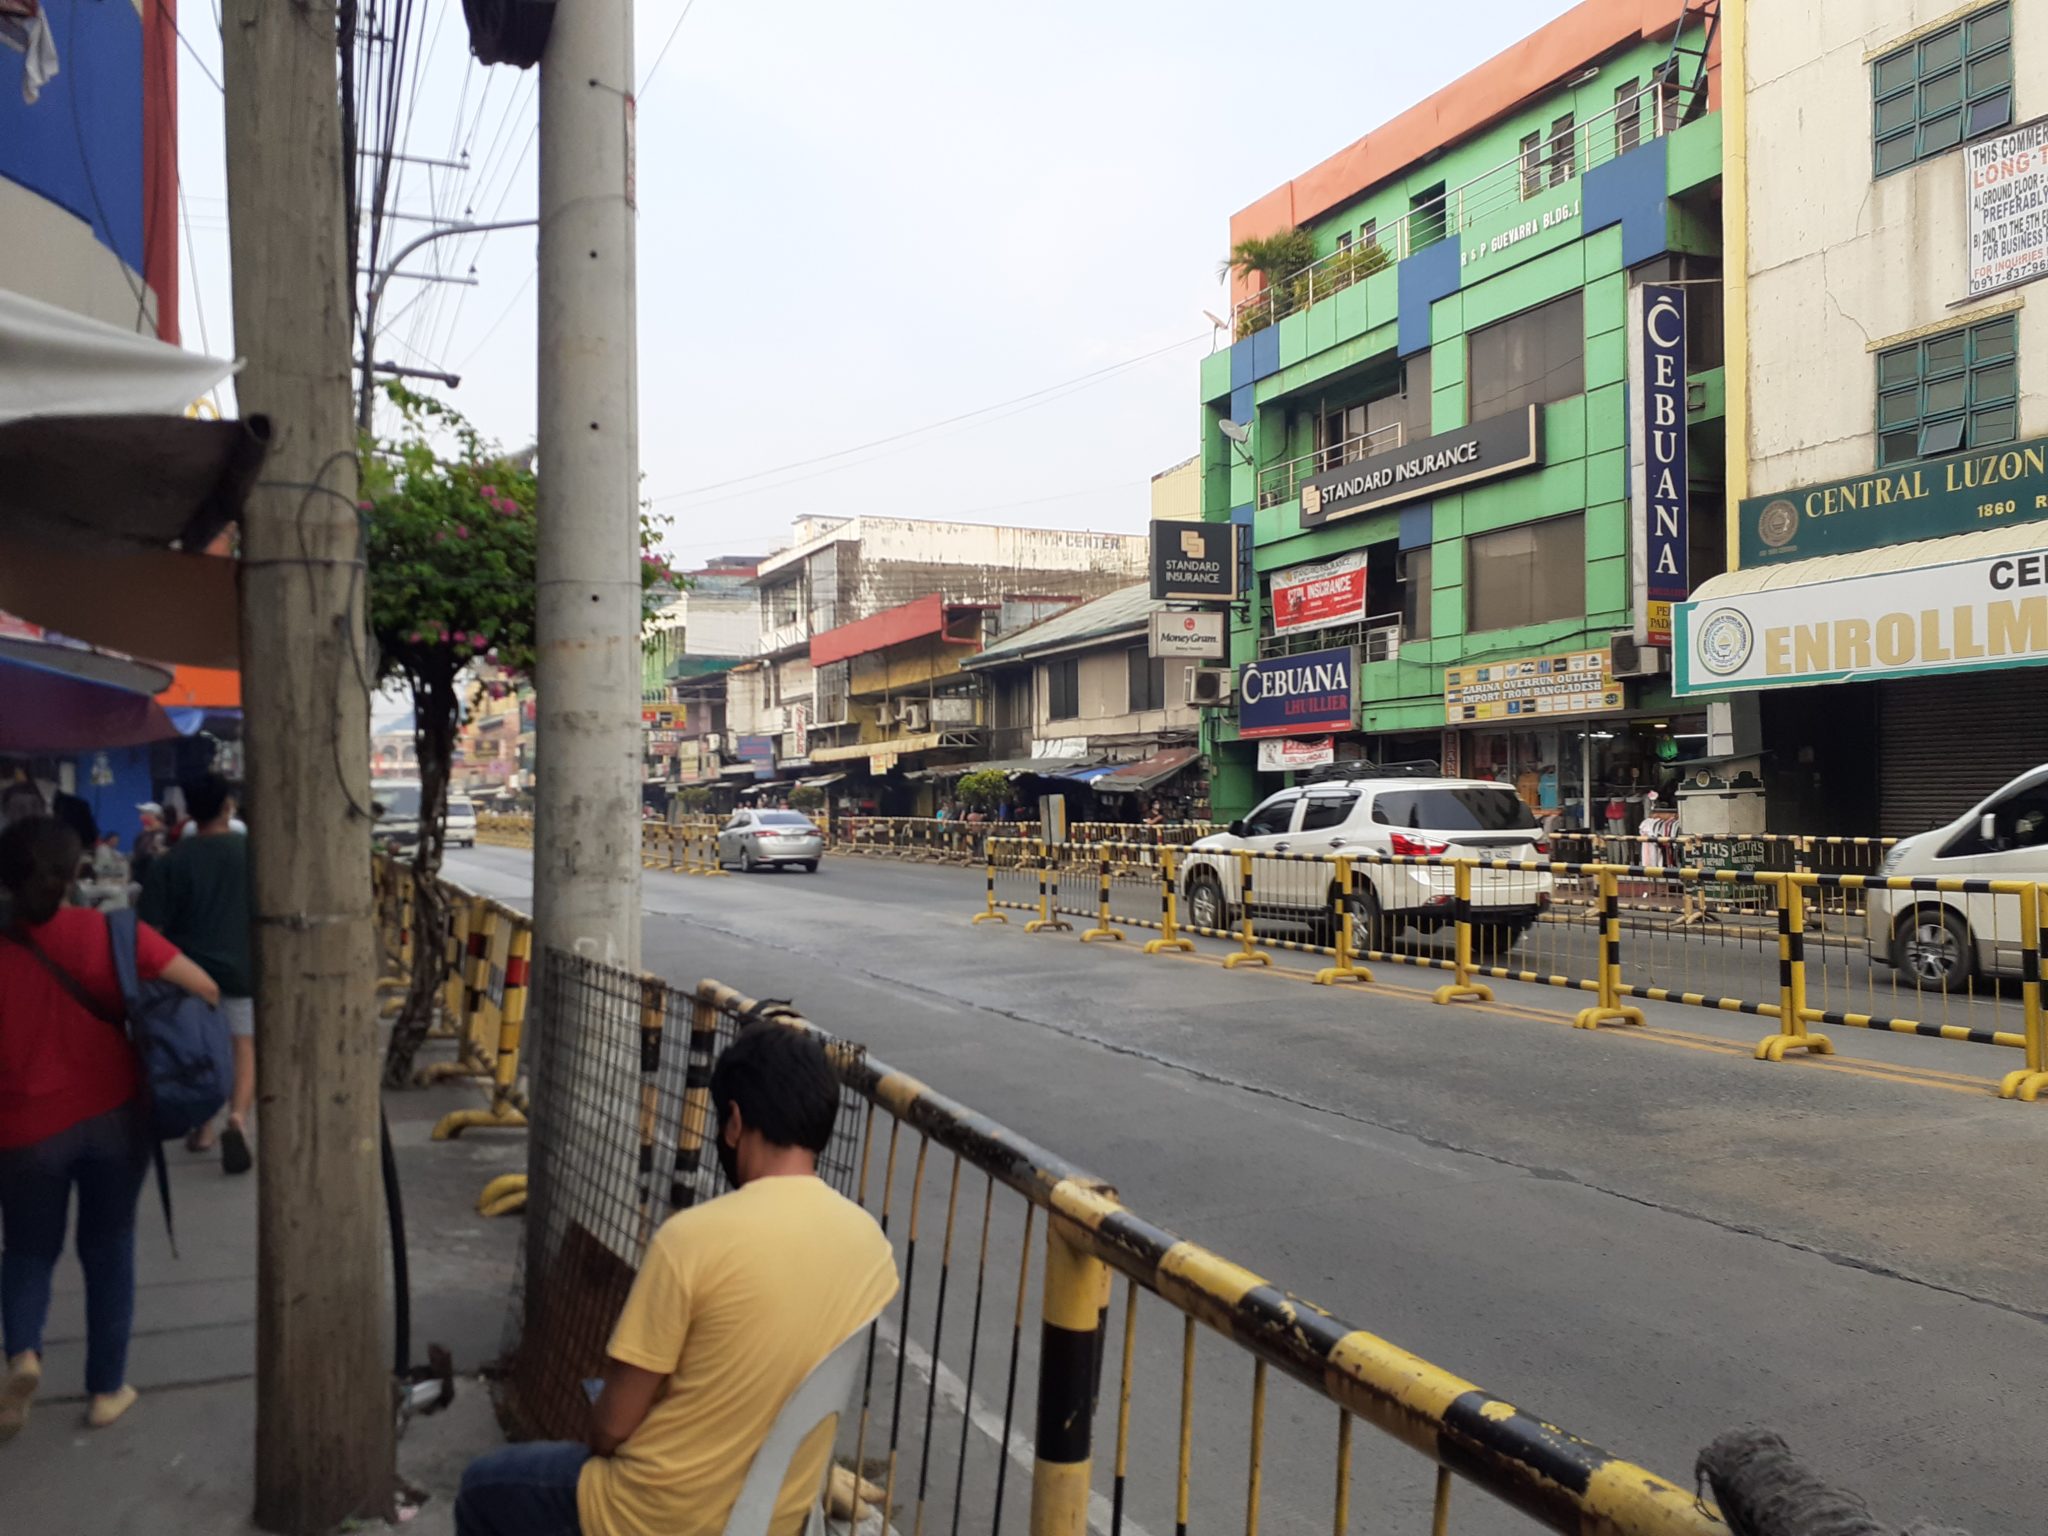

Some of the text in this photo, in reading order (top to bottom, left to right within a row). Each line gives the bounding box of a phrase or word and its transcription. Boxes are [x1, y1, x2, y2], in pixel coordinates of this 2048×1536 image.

[1973, 143, 1997, 168] THIS
[1983, 183, 2012, 207] GROUND
[1480, 243, 1487, 258] P
[1491, 219, 1539, 252] GUEVARRA
[1982, 227, 1996, 245] 2ND
[1998, 223, 2008, 240] TO
[2009, 217, 2023, 236] THE
[2026, 211, 2040, 231] 5TH
[1983, 228, 2043, 262] FOR BUSINESS
[1974, 248, 2043, 279] FOR INQUIRIES
[1647, 296, 1681, 575] CEBUANA
[1321, 440, 1478, 504] STANDARD INSURANCE
[1805, 445, 2045, 518] CENTRAL LUZON
[1977, 500, 2016, 518] 1860
[1166, 560, 1220, 572] STANDARD
[1166, 572, 1220, 583] INSURANCE
[1989, 554, 2048, 590] CE
[1650, 618, 1671, 629] PAD
[1765, 595, 2048, 675] ENROLLM
[1242, 662, 1348, 704] CEBUANA
[1463, 671, 1602, 695] ZARINA OVERRUN OUTLET
[1463, 681, 1602, 704] IMPORT FROM BANGLADESH
[1731, 841, 1764, 857] KEITH'S
